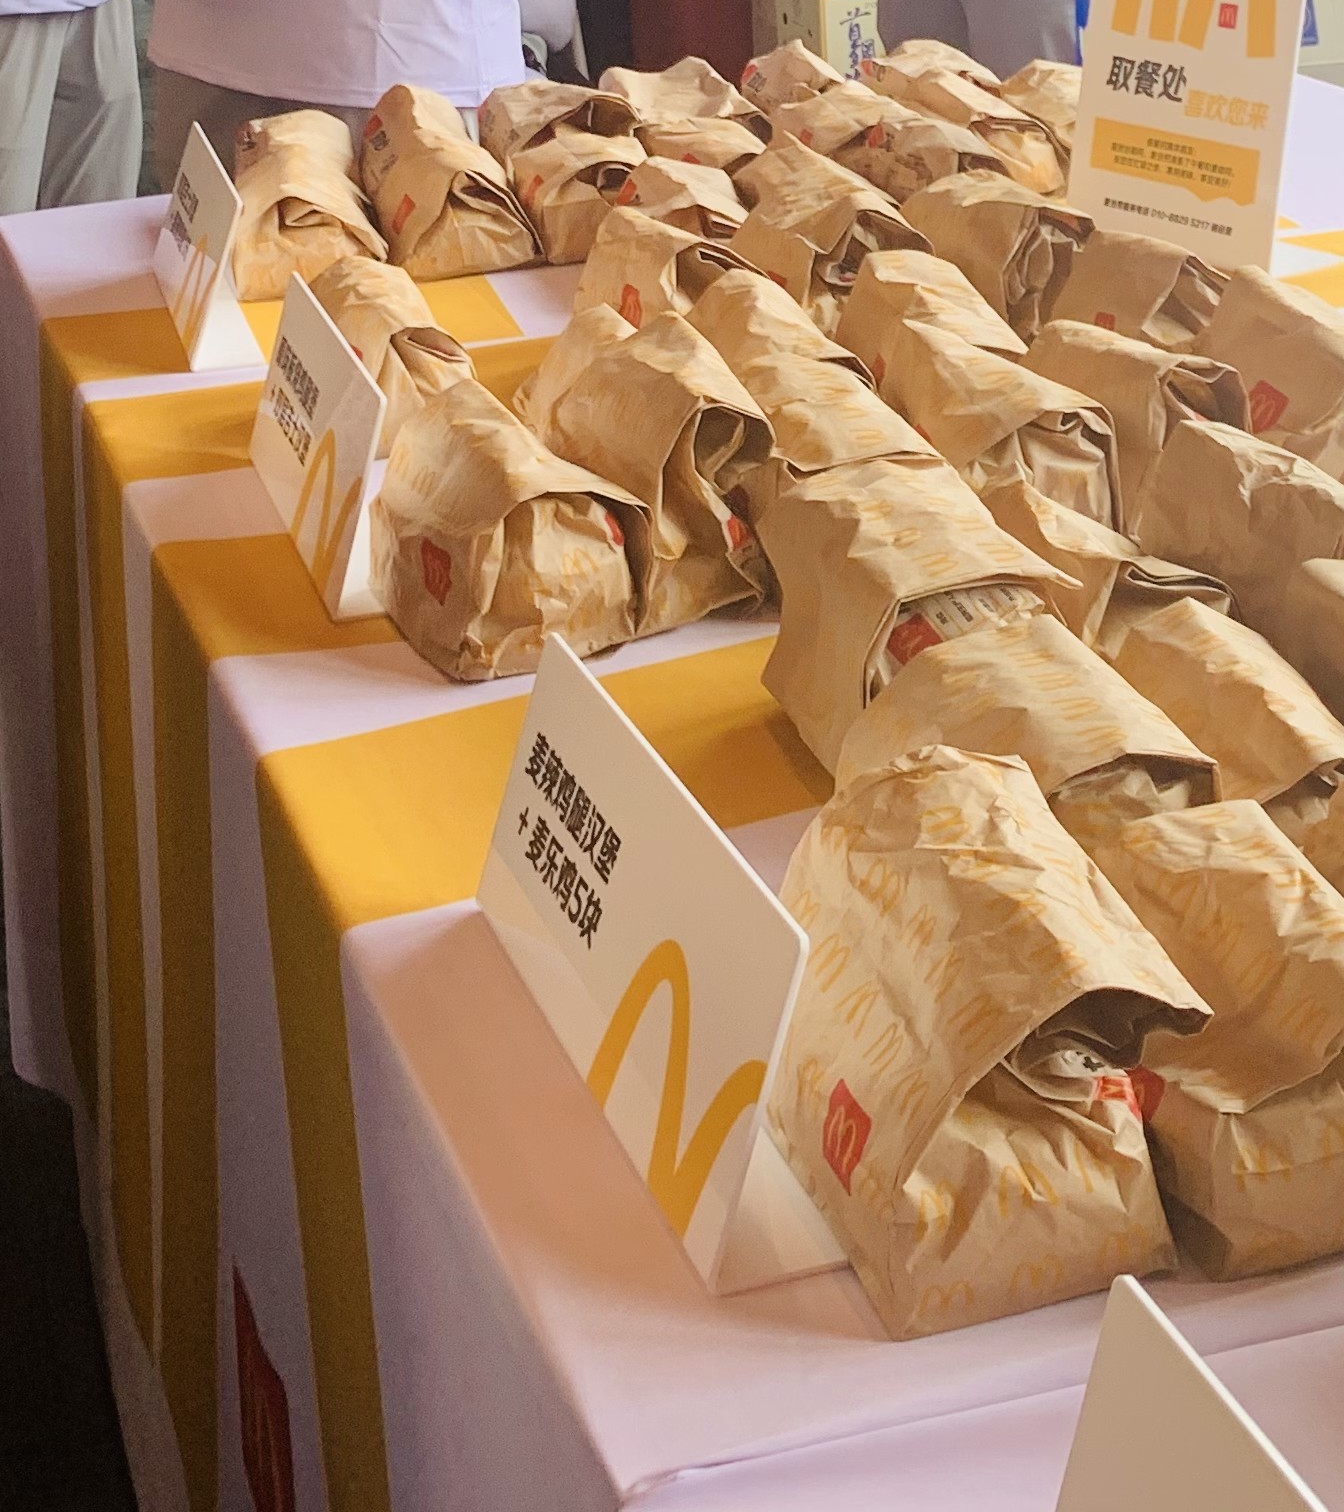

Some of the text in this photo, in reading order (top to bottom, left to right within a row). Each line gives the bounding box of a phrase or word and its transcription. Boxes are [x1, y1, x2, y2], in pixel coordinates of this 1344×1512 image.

[1106, 55, 1187, 103] 取餐处
[1185, 89, 1270, 130] 喜欢您来
[524, 731, 623, 886] 麦辣鸡腿汉堡
[523, 815, 604, 951] 麦乐鸡5块
